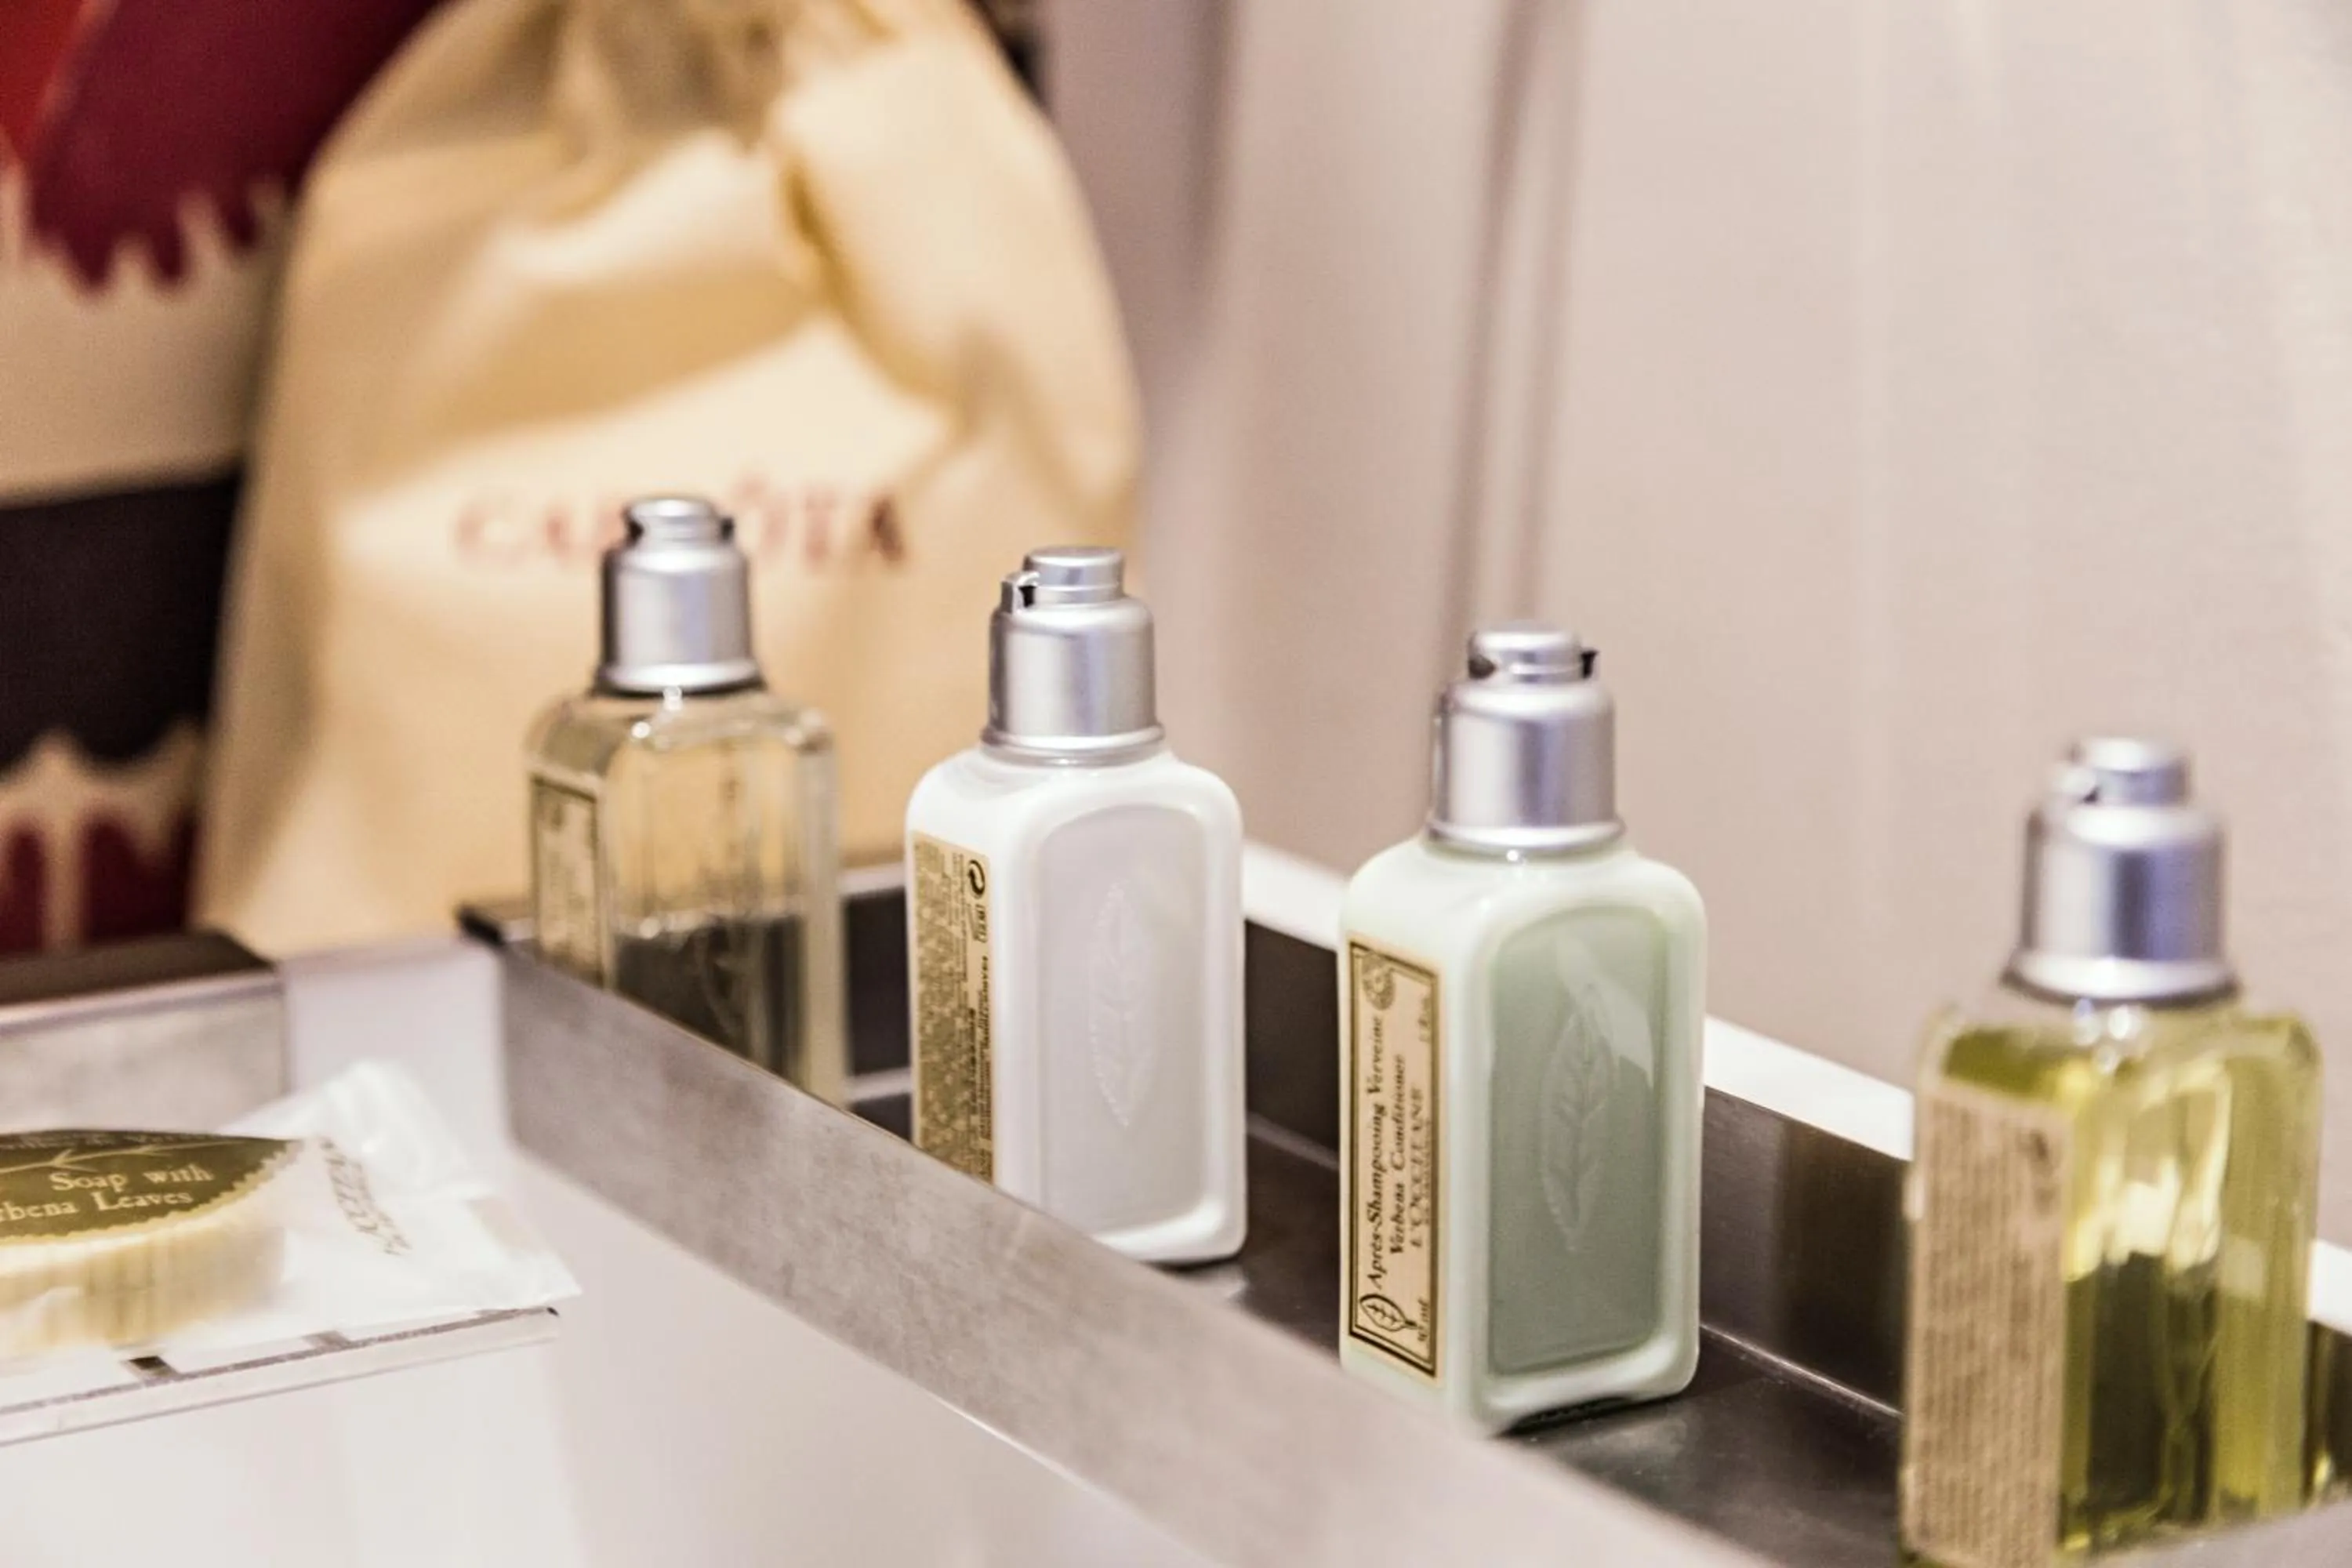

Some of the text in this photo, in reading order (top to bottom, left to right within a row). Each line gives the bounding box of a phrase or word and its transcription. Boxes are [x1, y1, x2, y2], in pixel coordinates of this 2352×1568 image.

[1367, 1016, 1383, 1094] Verveine
[49, 1163, 214, 1192] Soap with
[1390, 1054, 1405, 1254] Verbena Conditioner
[90, 1190, 194, 1211] Leaves
